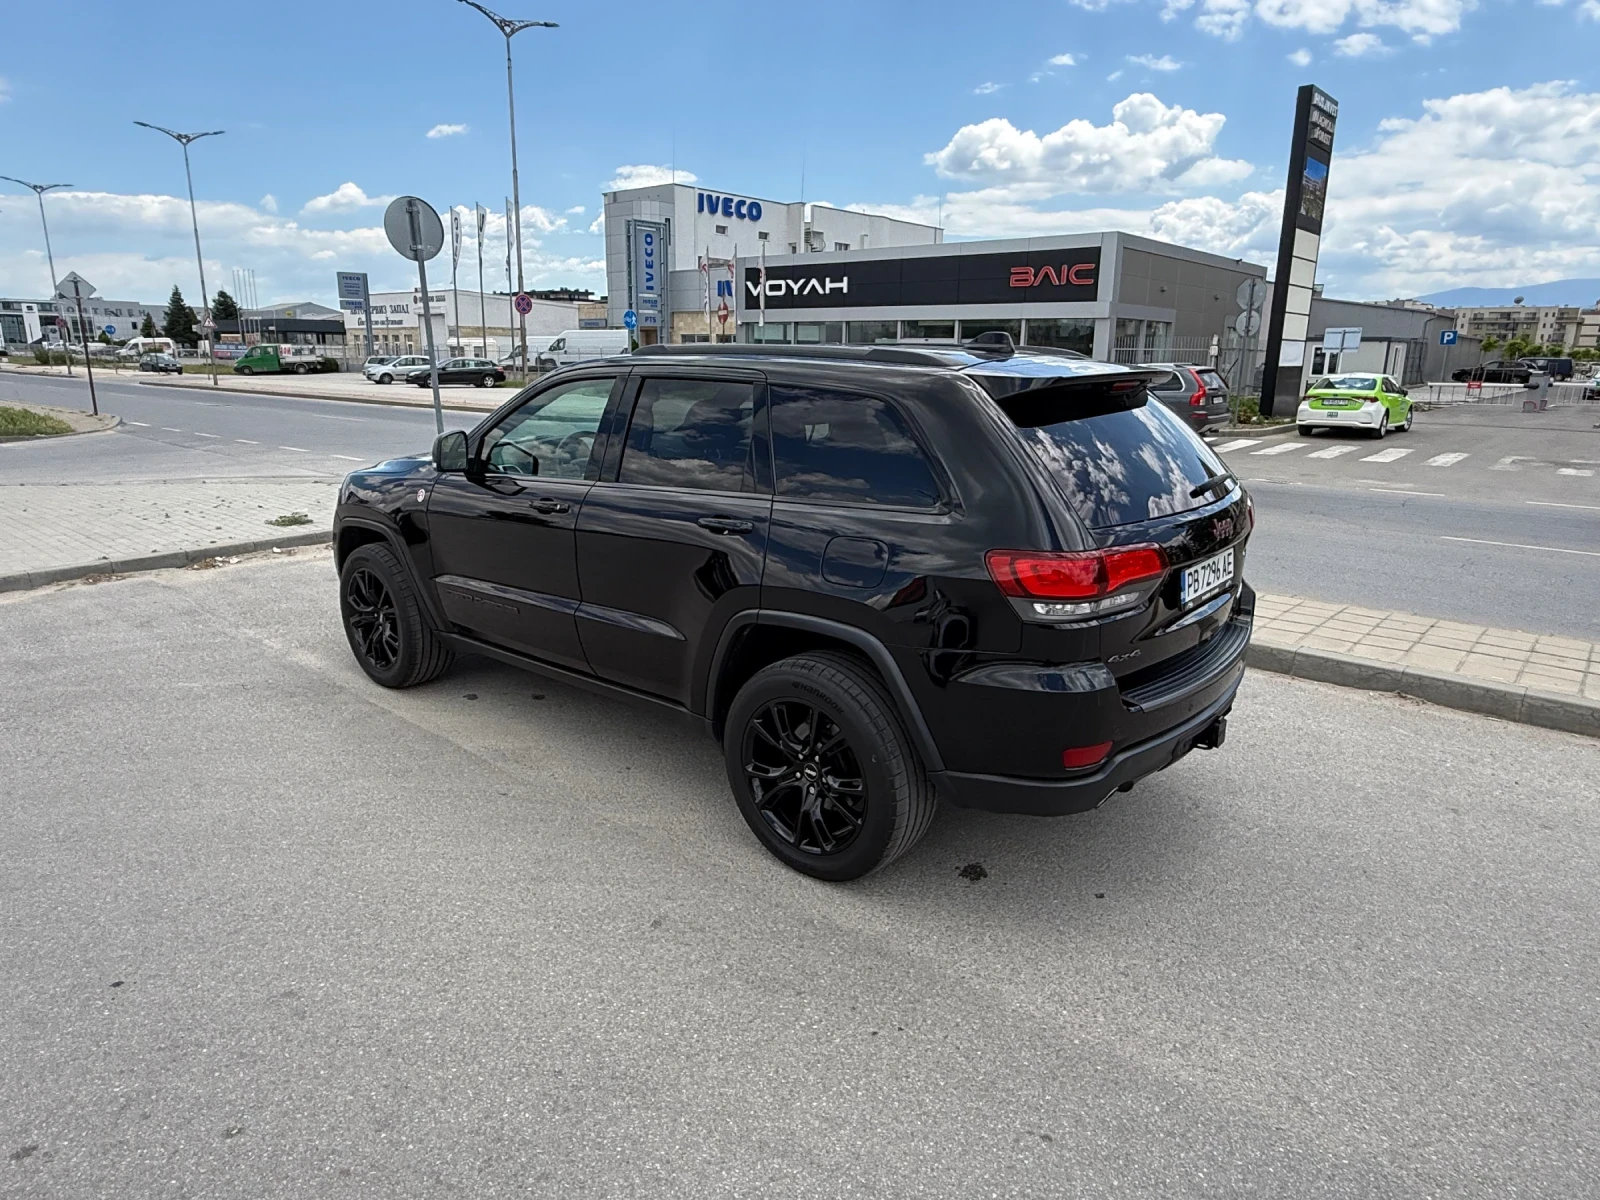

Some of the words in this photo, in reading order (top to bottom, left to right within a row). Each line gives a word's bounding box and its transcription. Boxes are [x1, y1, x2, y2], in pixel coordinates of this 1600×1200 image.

[697, 192, 762, 222] IVECO
[644, 233, 654, 291] IVECO
[1009, 263, 1096, 287] BAIC
[745, 276, 848, 297] VOYAH
[1443, 332, 1454, 344] P
[1187, 569, 1200, 597] PB
[1201, 558, 1221, 590] 7296
[1222, 551, 1233, 579] AE
